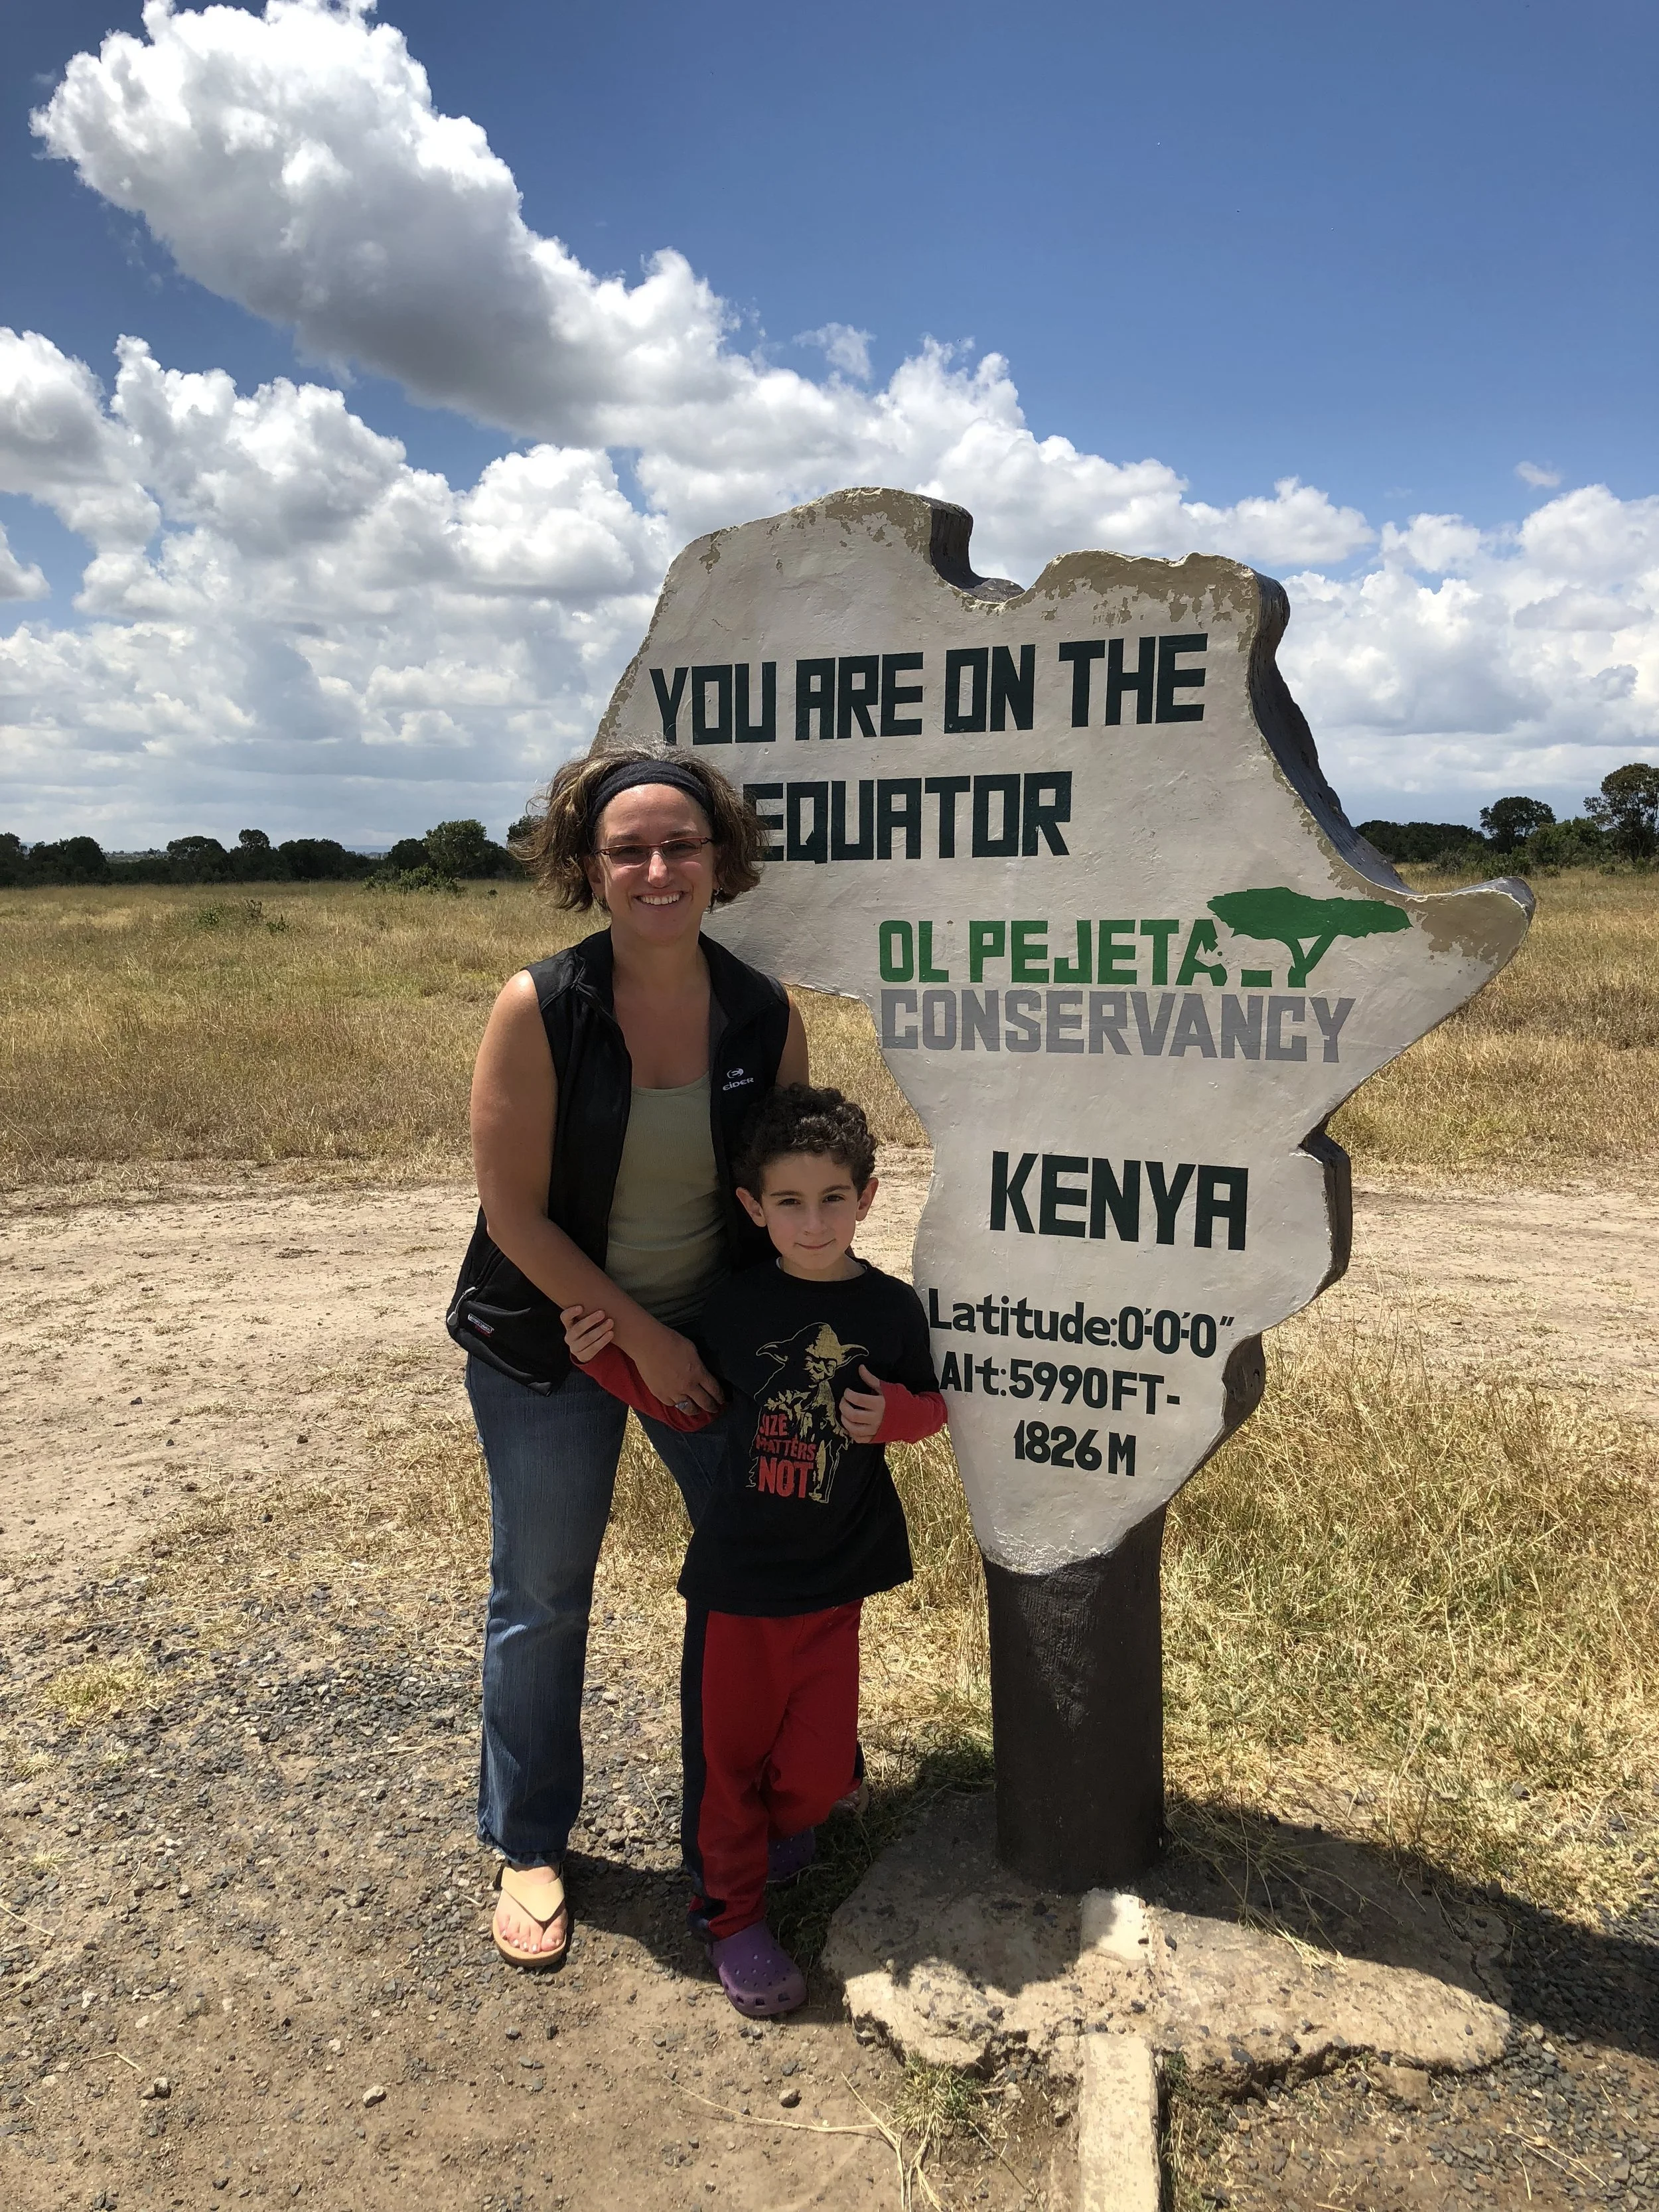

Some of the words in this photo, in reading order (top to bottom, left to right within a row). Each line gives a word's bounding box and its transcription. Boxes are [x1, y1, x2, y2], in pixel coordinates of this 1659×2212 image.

[648, 661, 776, 746] YOU
[796, 652, 924, 741] ARE
[944, 644, 1036, 734] ON
[1058, 633, 1208, 727] THE
[743, 771, 1072, 864] EQUATOR
[878, 920, 950, 983] OL
[968, 919, 1228, 988] PEJETA
[880, 989, 1356, 1063] CONSERVANCY
[989, 1150, 1249, 1251] KENYA
[756, 1434, 817, 1461] MATTERS
[758, 1455, 814, 1498] NOT
